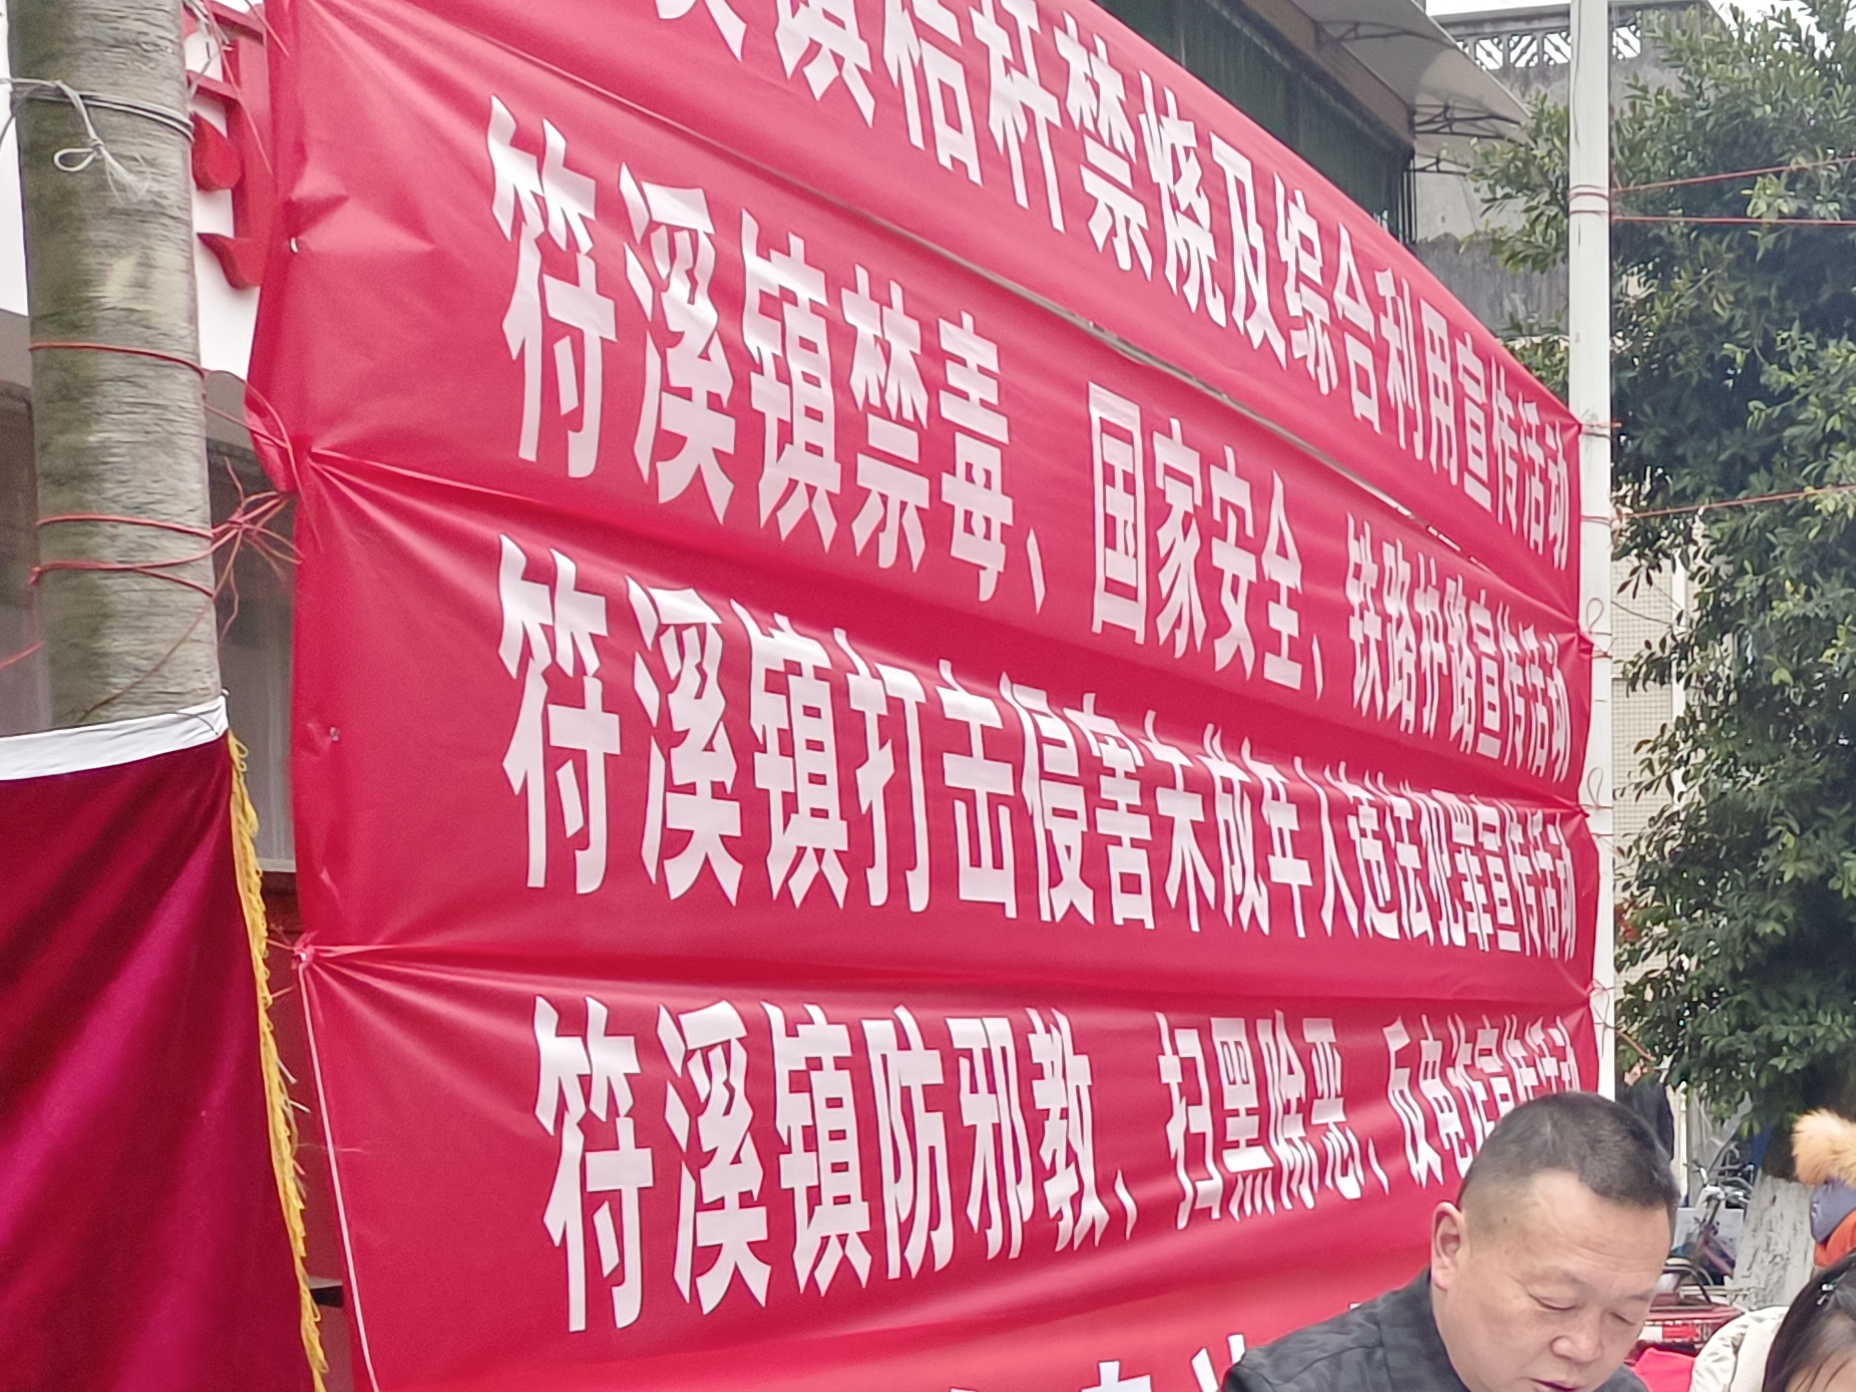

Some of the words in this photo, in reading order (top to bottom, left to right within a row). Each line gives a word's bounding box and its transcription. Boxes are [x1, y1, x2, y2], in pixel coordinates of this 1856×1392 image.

[488, 96, 1572, 782] 符溪镇禁毒、国家安全、铁路护路宣传活动
[656, 0, 1569, 571] 镇秸秆禁烧及综合利用宣传活动
[499, 535, 1576, 961] 符溪镇打击侵害未成年人违法犯罪宣传活动
